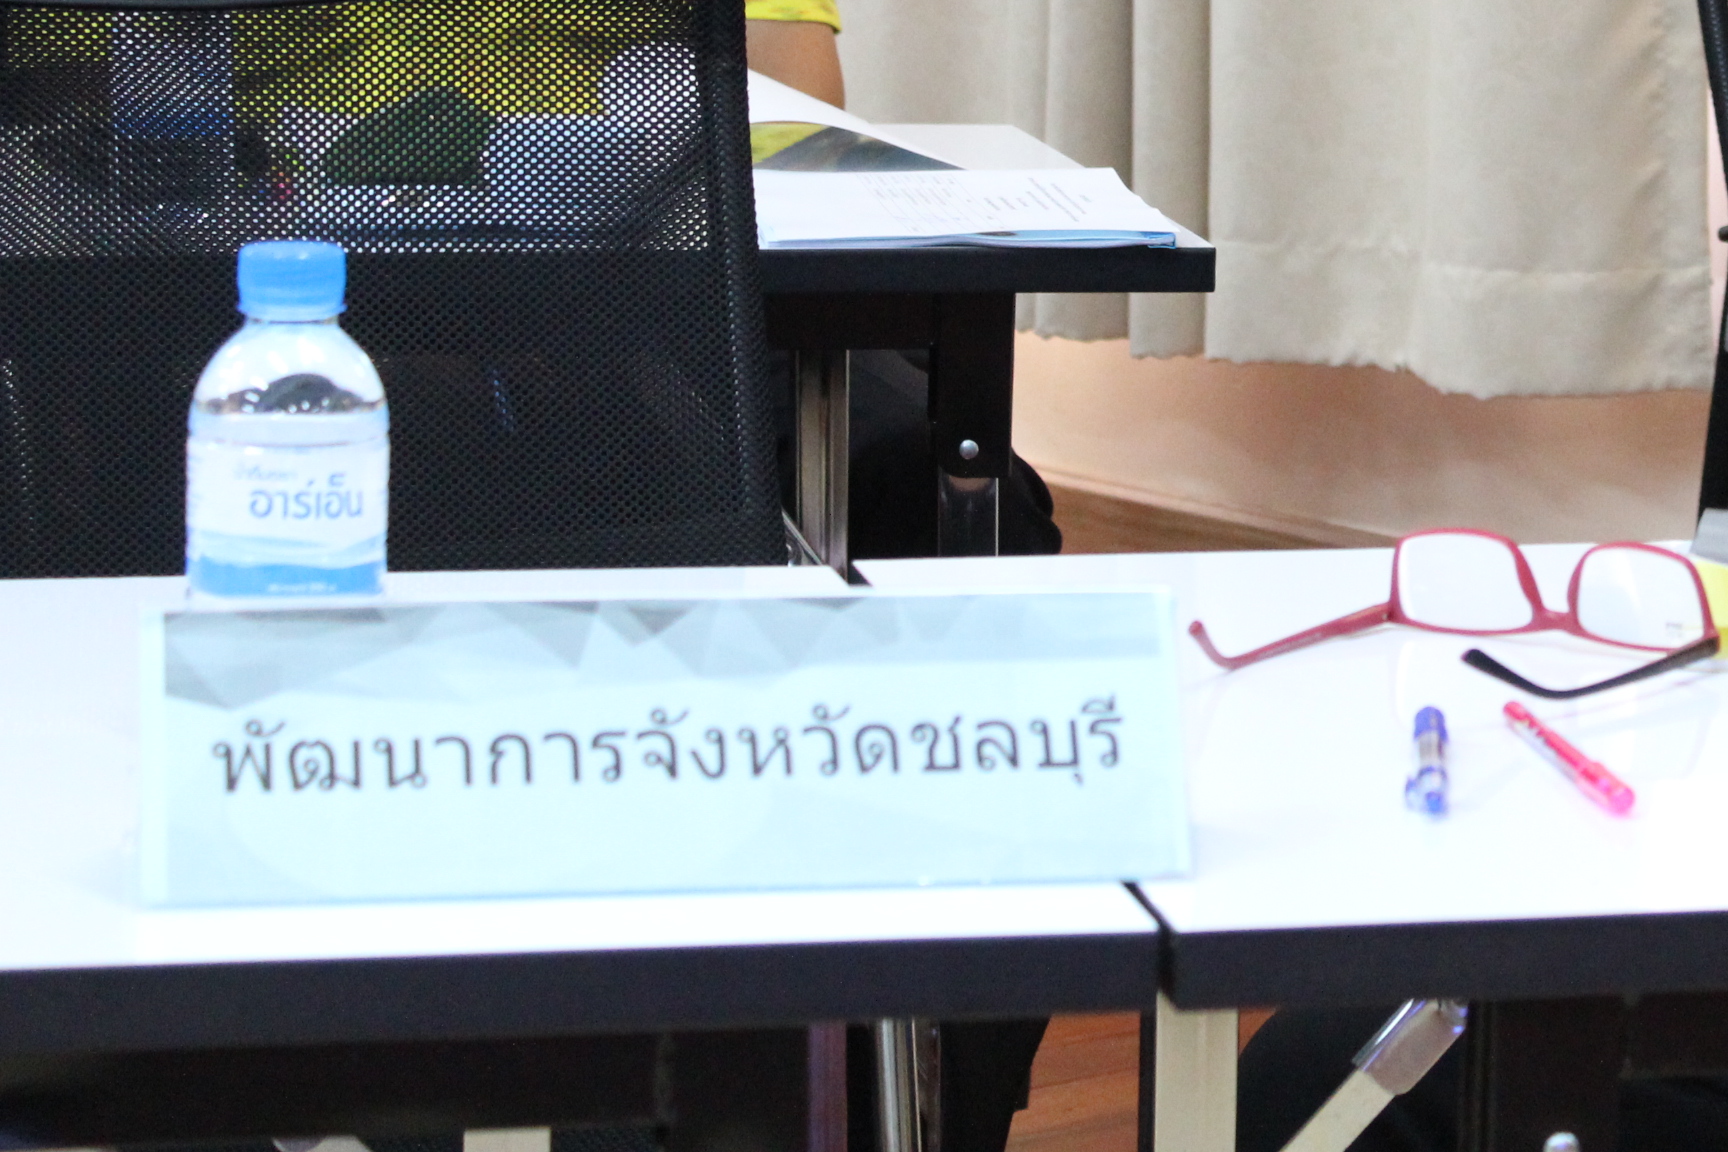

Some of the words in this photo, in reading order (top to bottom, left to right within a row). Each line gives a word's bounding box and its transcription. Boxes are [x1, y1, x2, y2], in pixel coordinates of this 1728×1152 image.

[249, 471, 363, 519] อาร์เอ็น
[213, 695, 1123, 792] พัฒนาการจังหวัดชลบุรี
